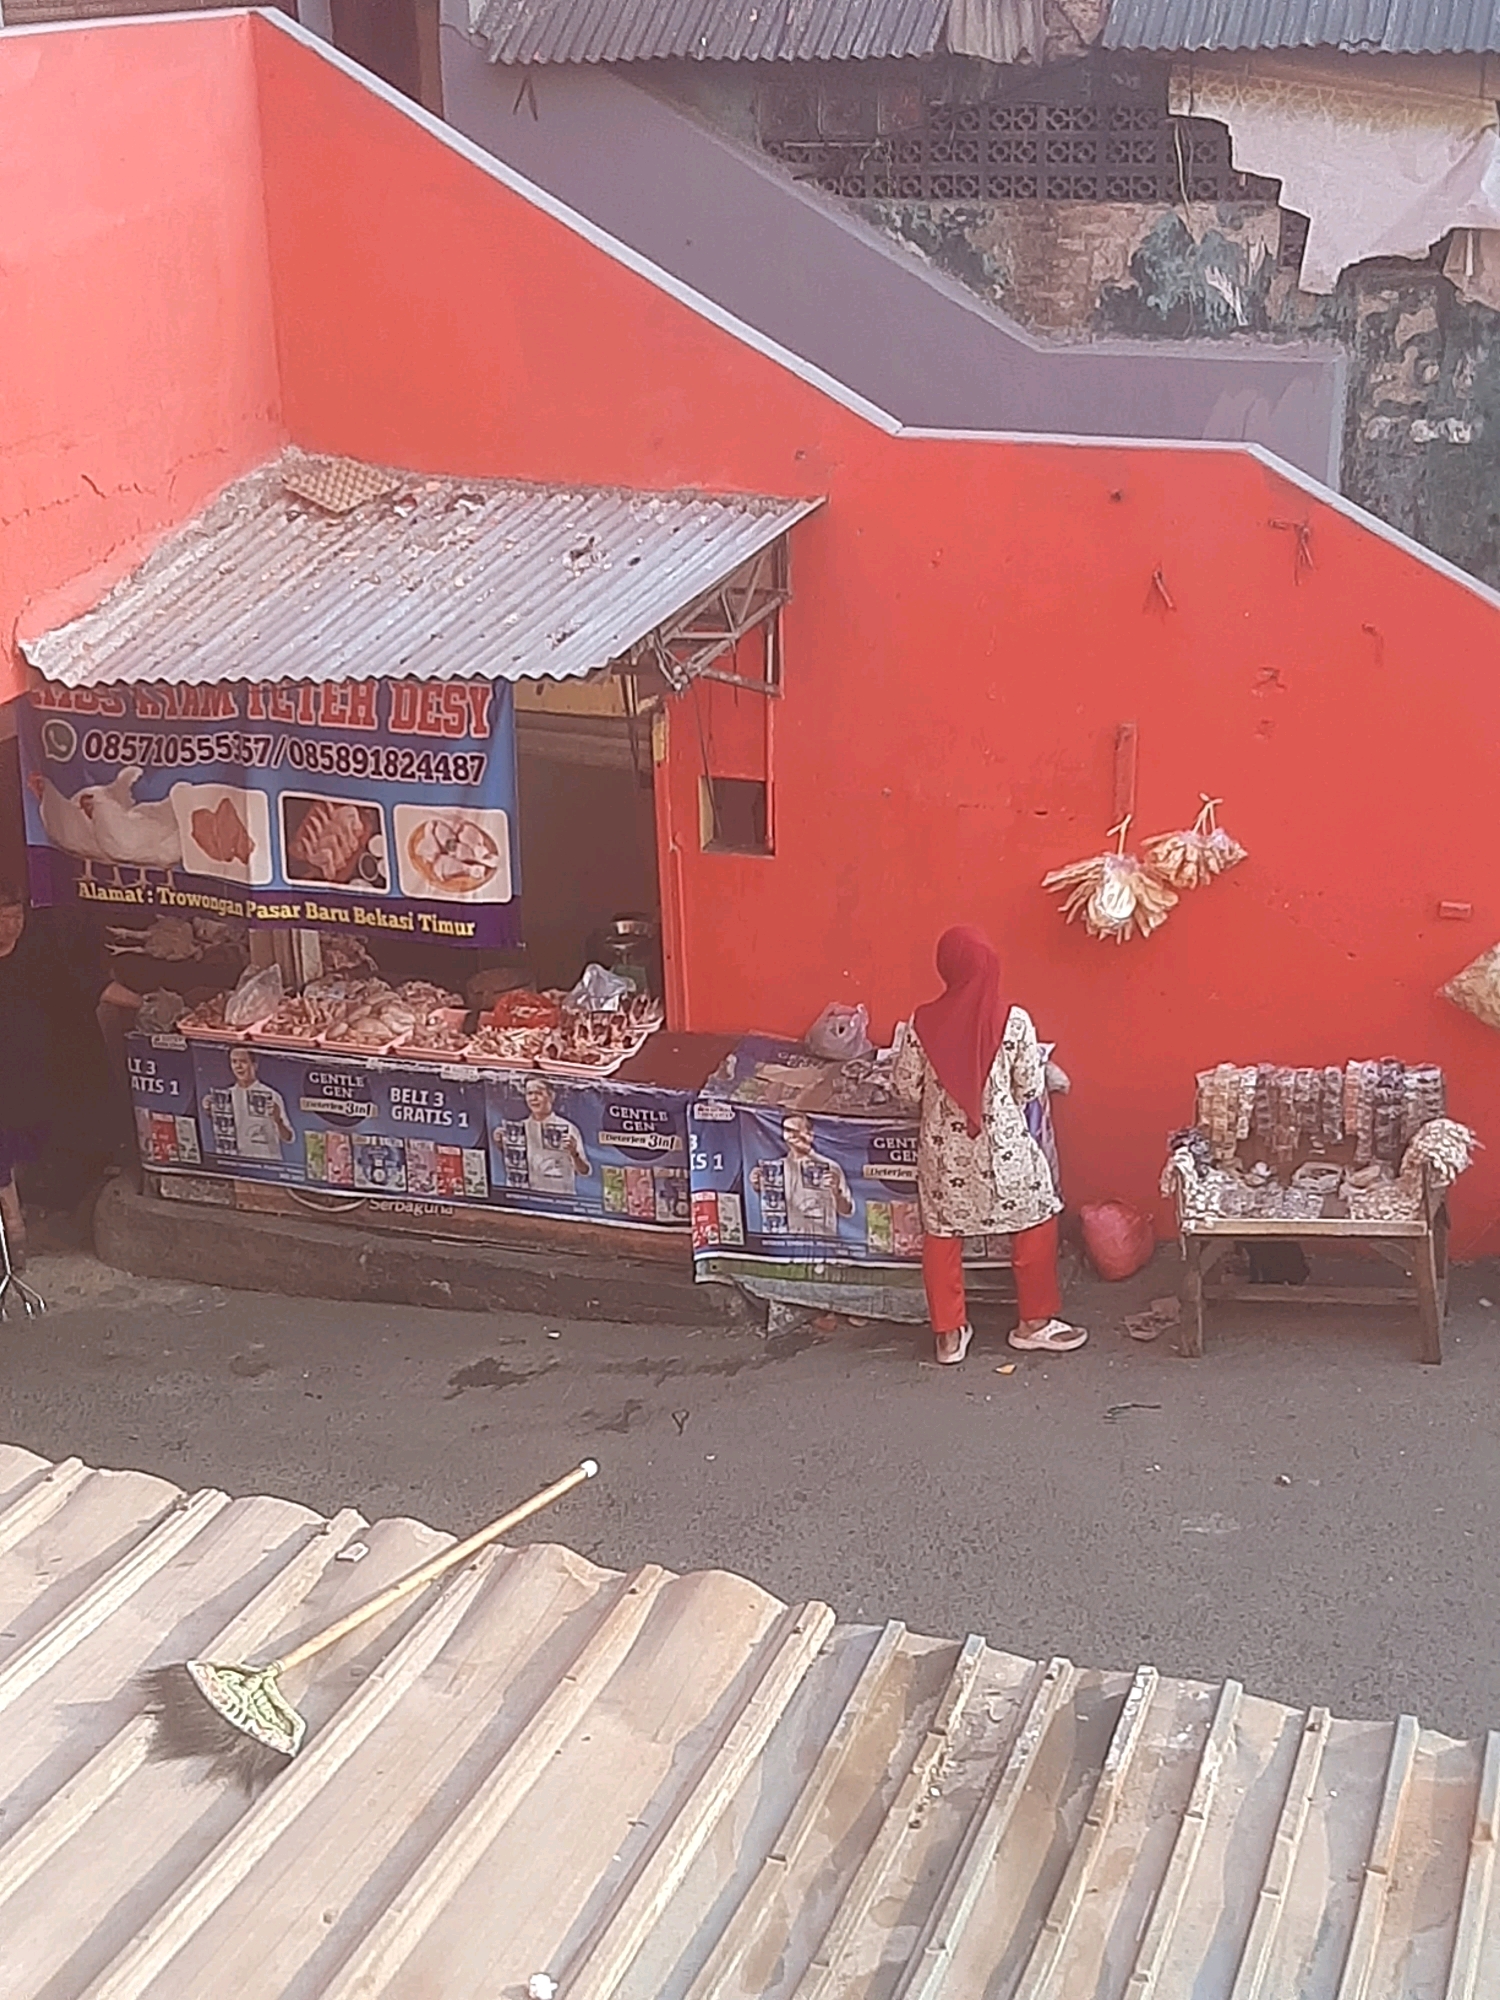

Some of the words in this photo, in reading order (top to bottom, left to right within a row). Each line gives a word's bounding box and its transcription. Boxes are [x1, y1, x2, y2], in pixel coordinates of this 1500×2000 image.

[388, 681, 492, 738] DESY
[78, 882, 145, 903] Alamat
[156, 886, 243, 917] Trowongan
[246, 900, 300, 919] Pasar
[304, 901, 350, 923] Baru
[353, 906, 414, 930] Bekasi
[418, 913, 476, 937] Timur
[146, 1060, 156, 1075] 3
[309, 1071, 365, 1087] GENTLE
[170, 1080, 179, 1095] 1
[322, 1085, 353, 1098] GEN
[390, 1087, 428, 1105] BELI
[433, 1091, 444, 1107] 3
[391, 1105, 453, 1126] GRATIS
[458, 1112, 469, 1128] 1
[609, 1105, 668, 1121] GENTLE
[622, 1120, 655, 1131] GEN
[713, 1153, 723, 1170] 1
